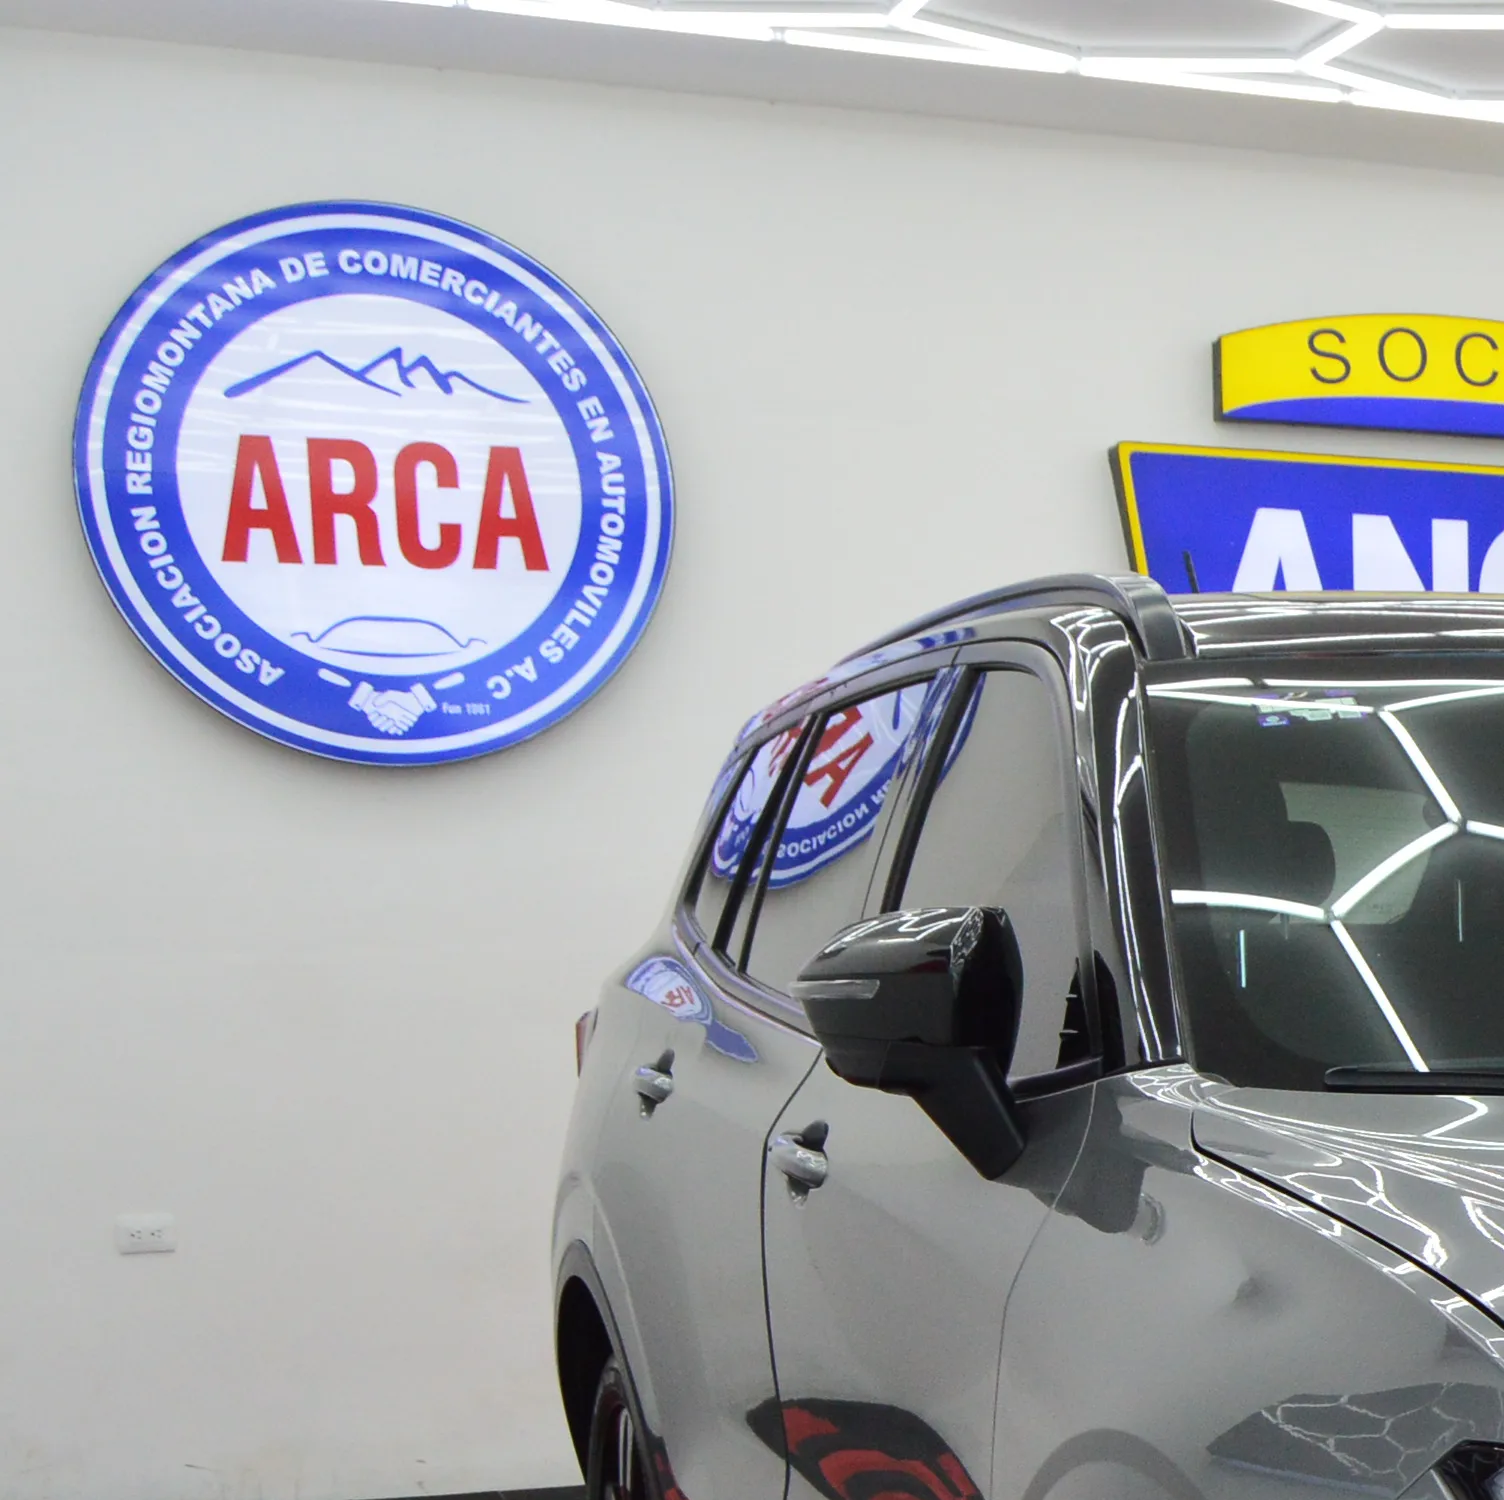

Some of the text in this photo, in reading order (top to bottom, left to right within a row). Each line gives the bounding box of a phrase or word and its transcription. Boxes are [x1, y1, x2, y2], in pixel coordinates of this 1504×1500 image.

[278, 251, 330, 284] DE
[337, 249, 588, 393] COMERCIANTES
[125, 268, 277, 495] REGIOMONTANA
[576, 395, 614, 444] EN
[221, 433, 550, 572] ARCA
[538, 451, 627, 664] AUTOMOVILES
[129, 505, 286, 686] ASOCIACION
